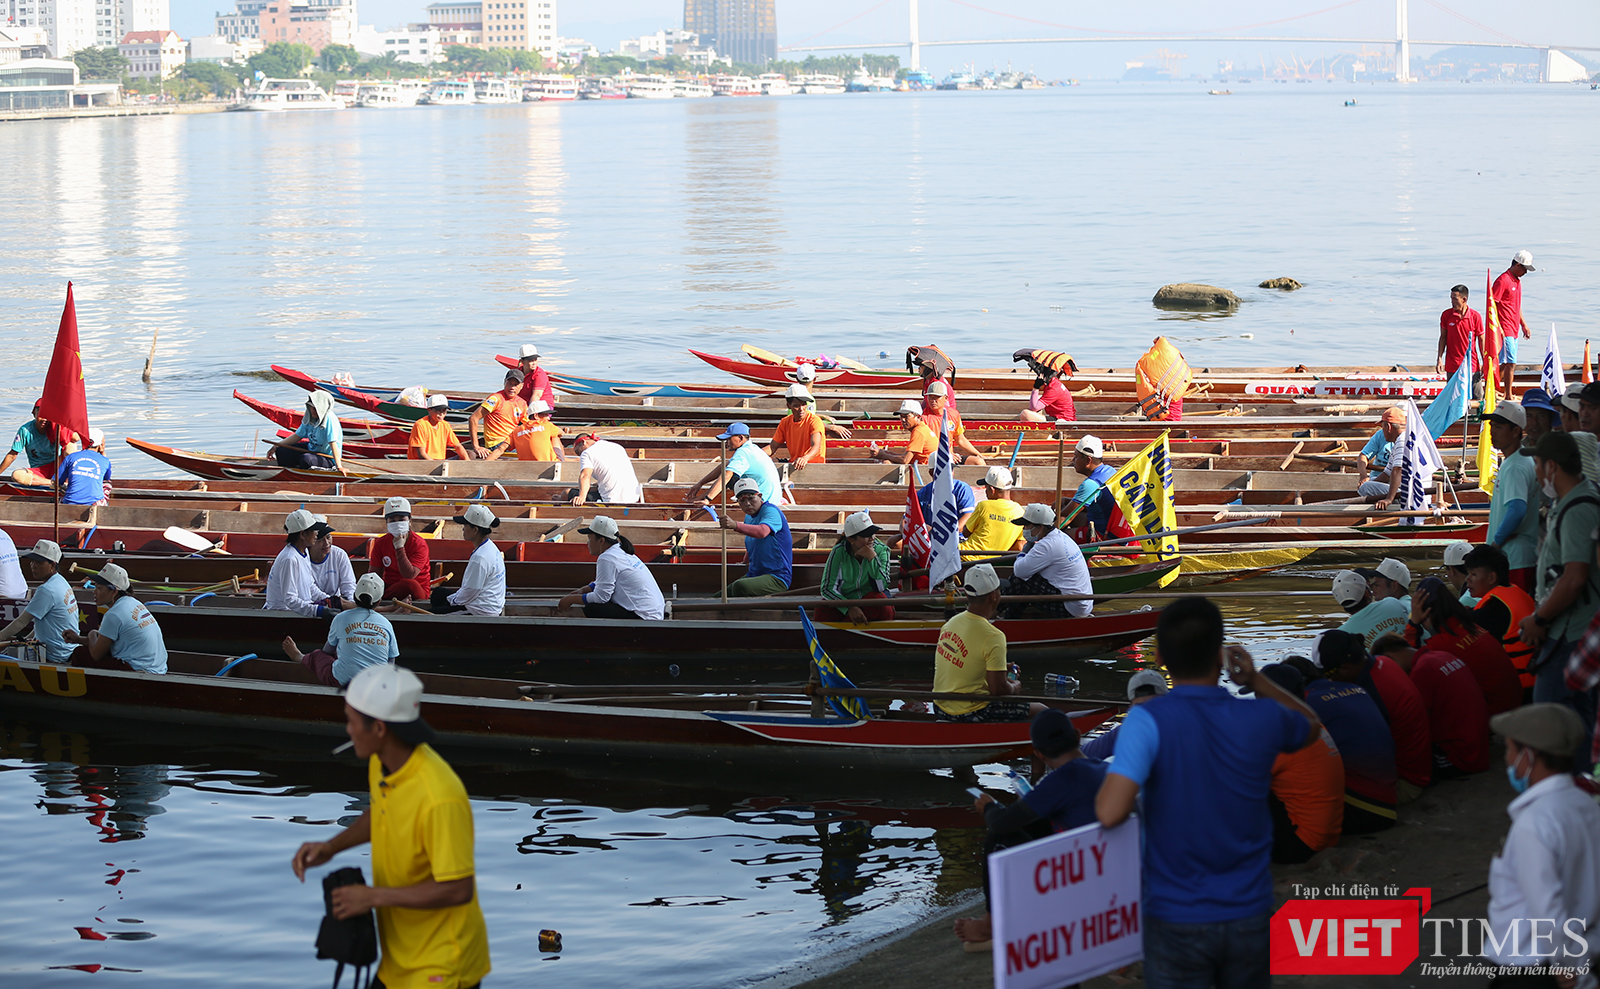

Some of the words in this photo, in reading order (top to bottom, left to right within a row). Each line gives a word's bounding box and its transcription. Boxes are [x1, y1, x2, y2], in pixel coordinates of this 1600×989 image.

[1324, 387, 1404, 396] THANH
[1034, 839, 1084, 896] CHÚ
[1090, 831, 1107, 877] Ý
[1006, 921, 1077, 977] NGUY
[1081, 893, 1139, 951] HIỂM
